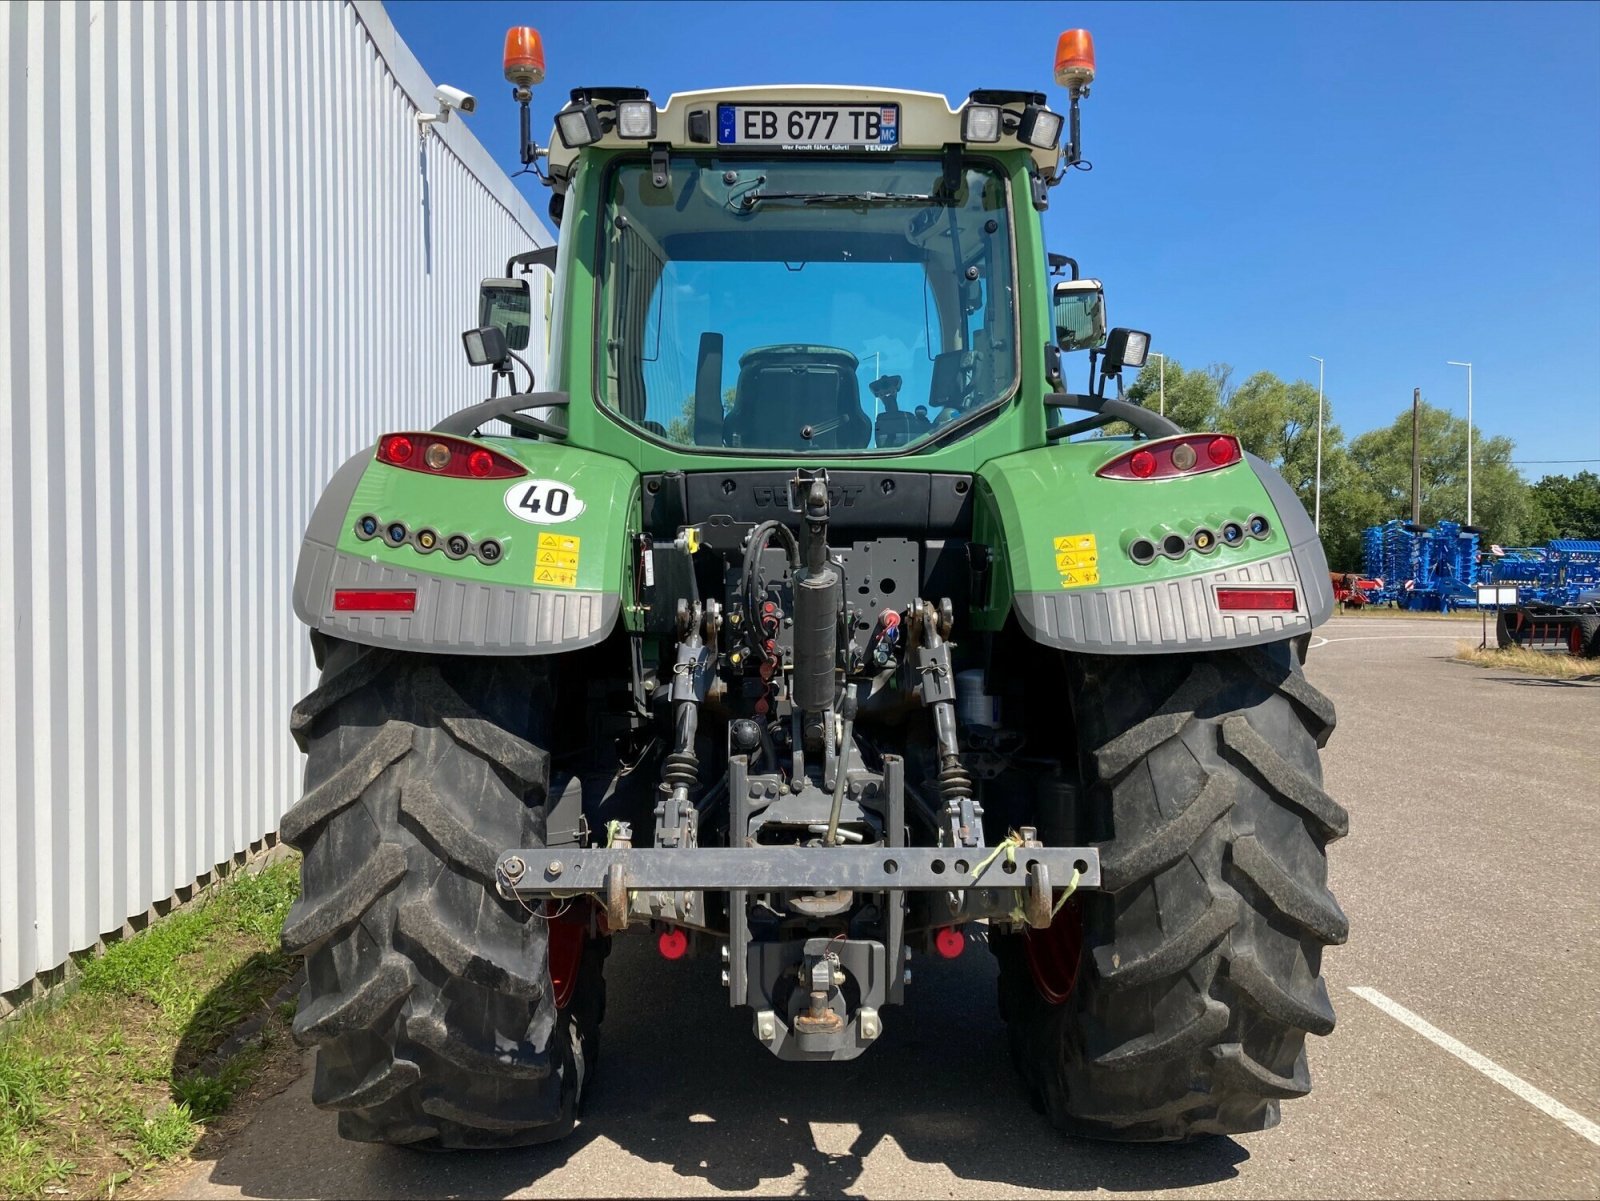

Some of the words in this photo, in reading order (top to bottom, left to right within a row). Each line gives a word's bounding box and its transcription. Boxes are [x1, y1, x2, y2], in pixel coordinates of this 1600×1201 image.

[725, 128, 731, 138] F
[744, 111, 778, 139] EB
[787, 110, 839, 140] 677
[848, 111, 881, 140] TB
[881, 128, 896, 141] MC
[519, 485, 569, 516] 40
[752, 486, 865, 508] FEDT
